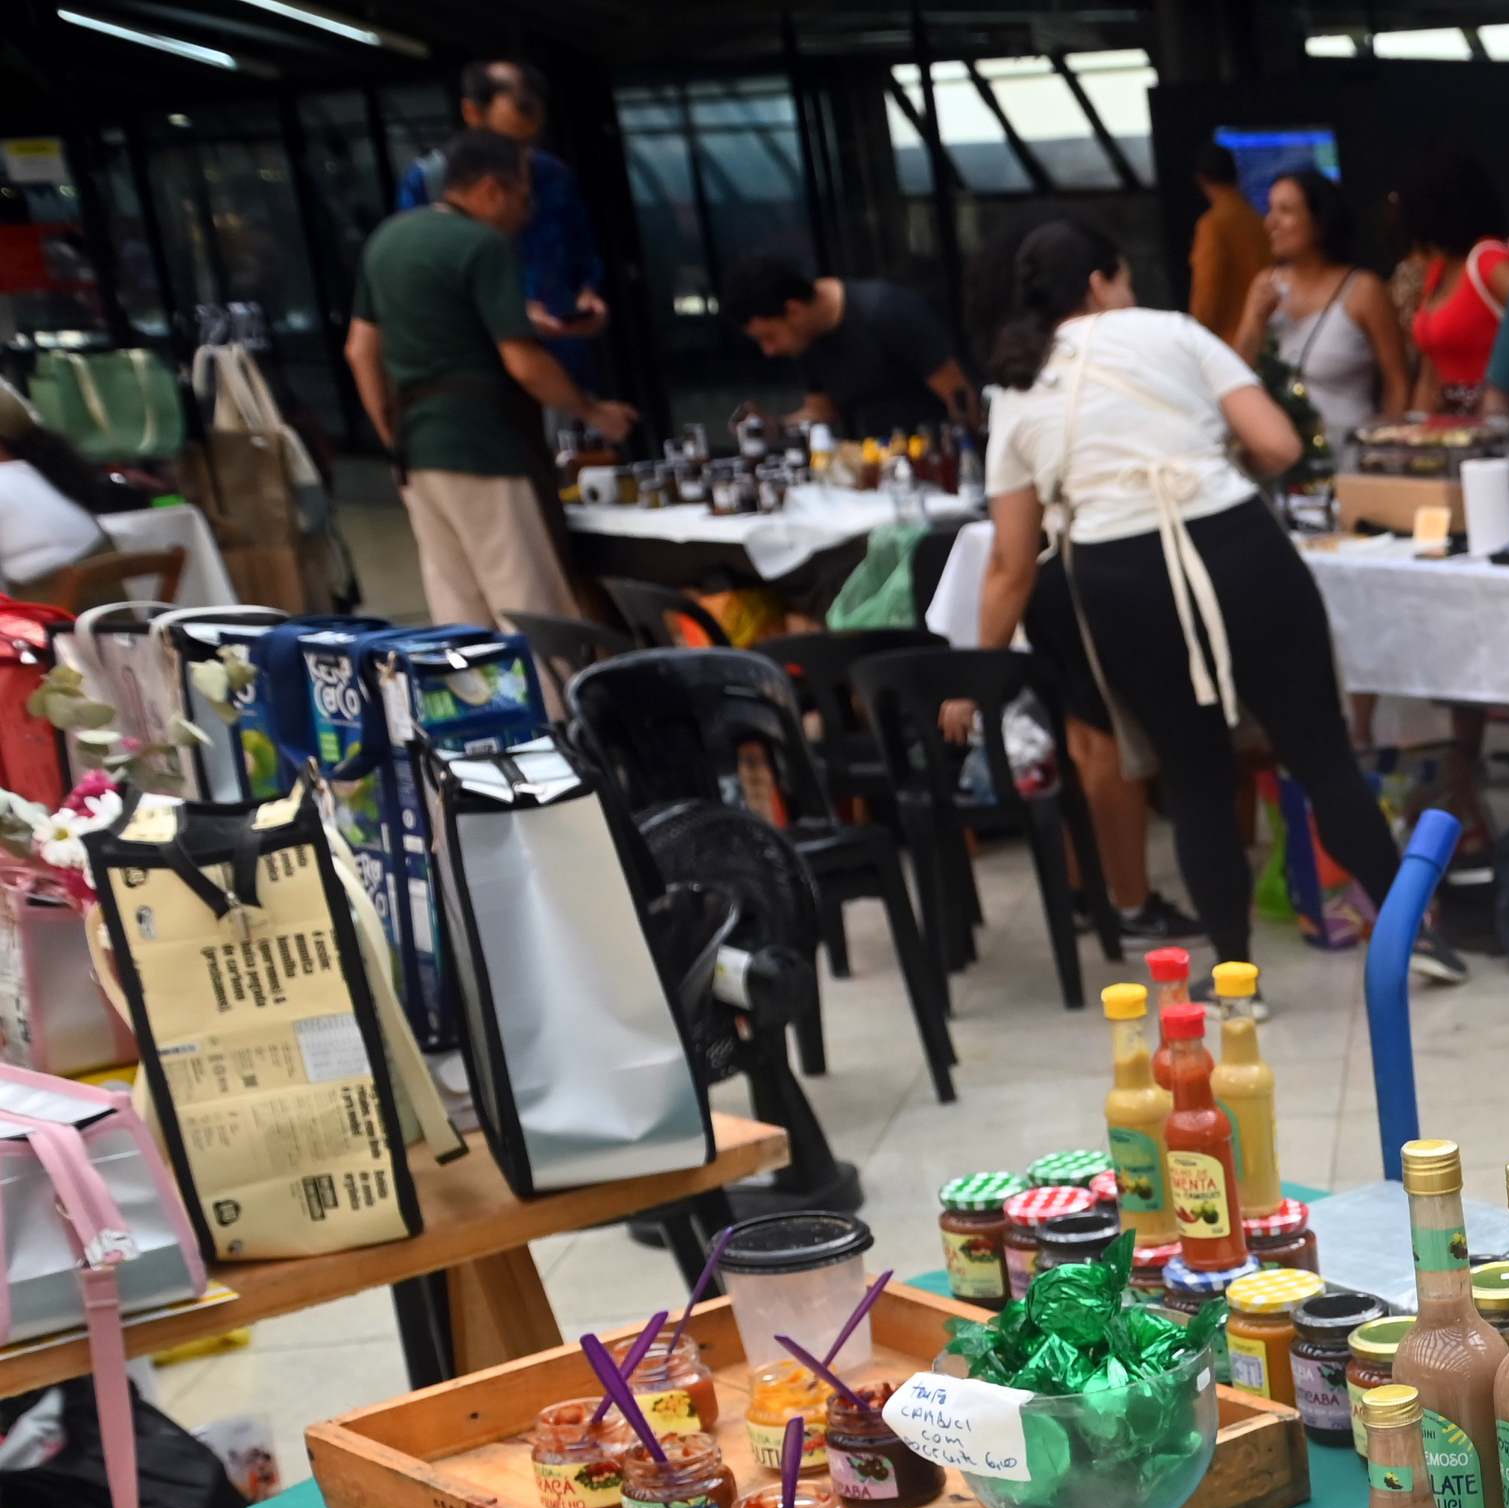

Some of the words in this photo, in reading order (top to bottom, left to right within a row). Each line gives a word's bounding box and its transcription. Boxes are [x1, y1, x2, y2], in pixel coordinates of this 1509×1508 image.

[1173, 1178, 1217, 1191] MENTA
[1424, 1451, 1469, 1467] EMOSO
[537, 1477, 576, 1501] RAÇÁ
